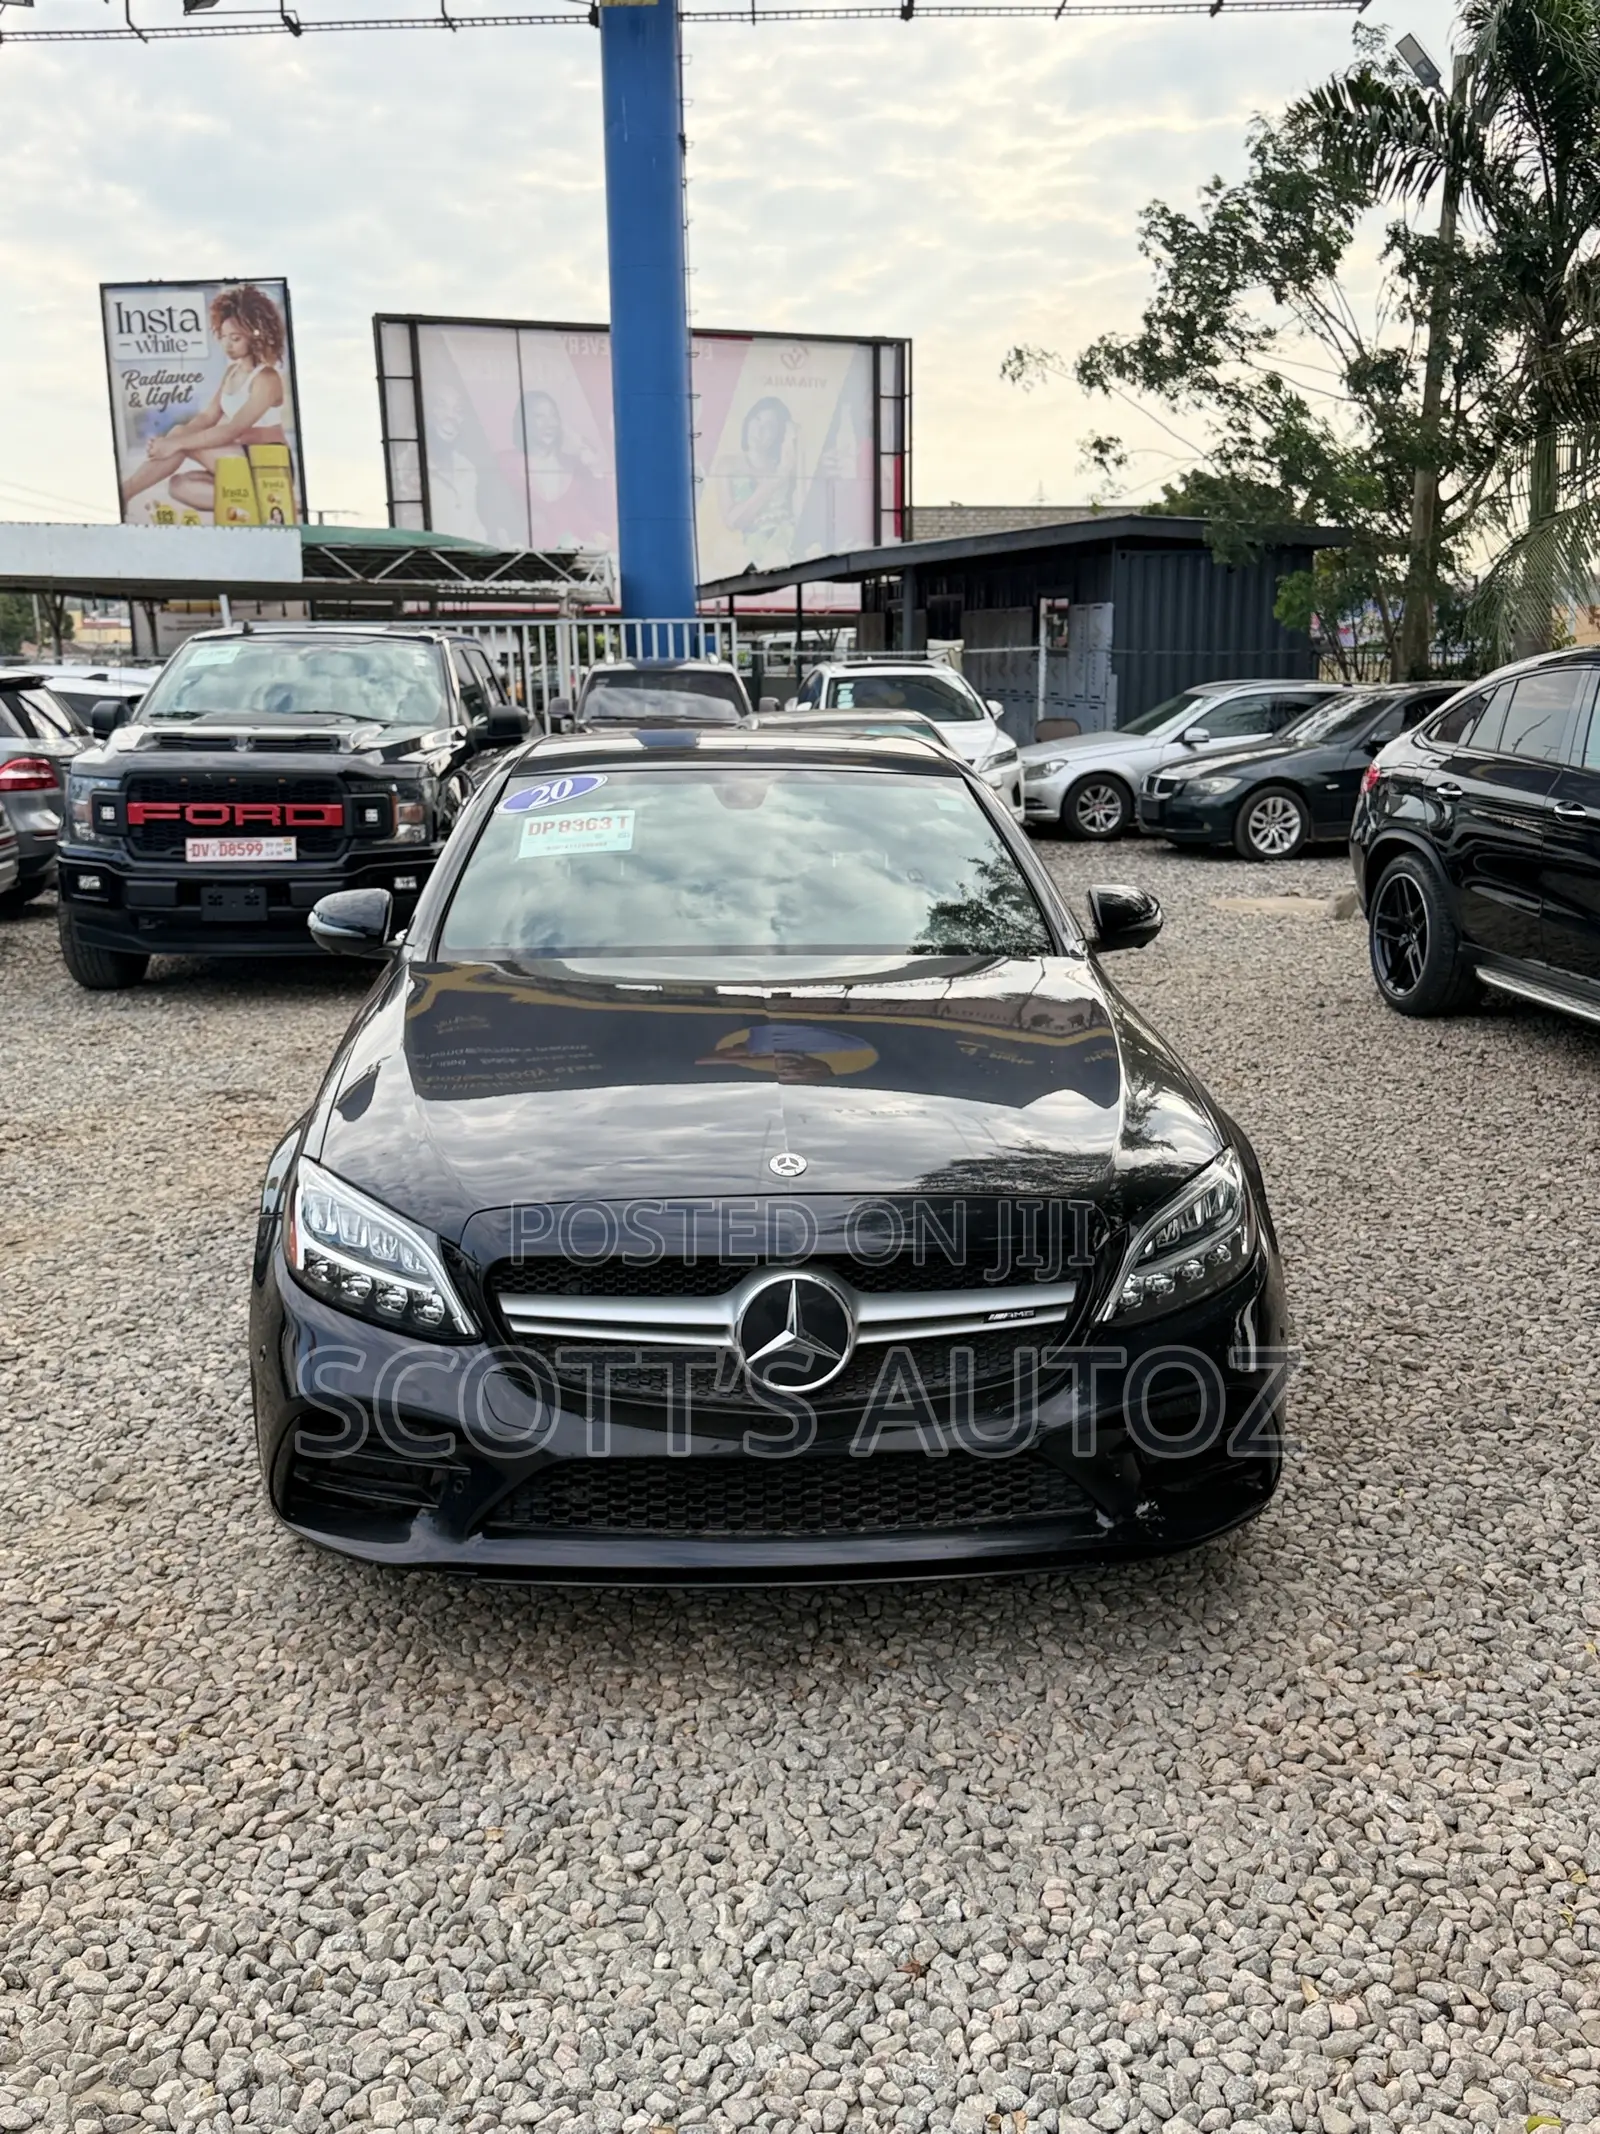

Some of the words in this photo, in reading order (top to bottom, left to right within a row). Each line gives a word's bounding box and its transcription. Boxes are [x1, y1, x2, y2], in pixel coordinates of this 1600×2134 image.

[114, 301, 202, 335] Insta
[134, 334, 189, 354] white
[121, 368, 205, 391] Radiance
[128, 391, 143, 409] &
[145, 384, 194, 413] light
[529, 778, 574, 809] 20
[127, 802, 344, 827] FORD
